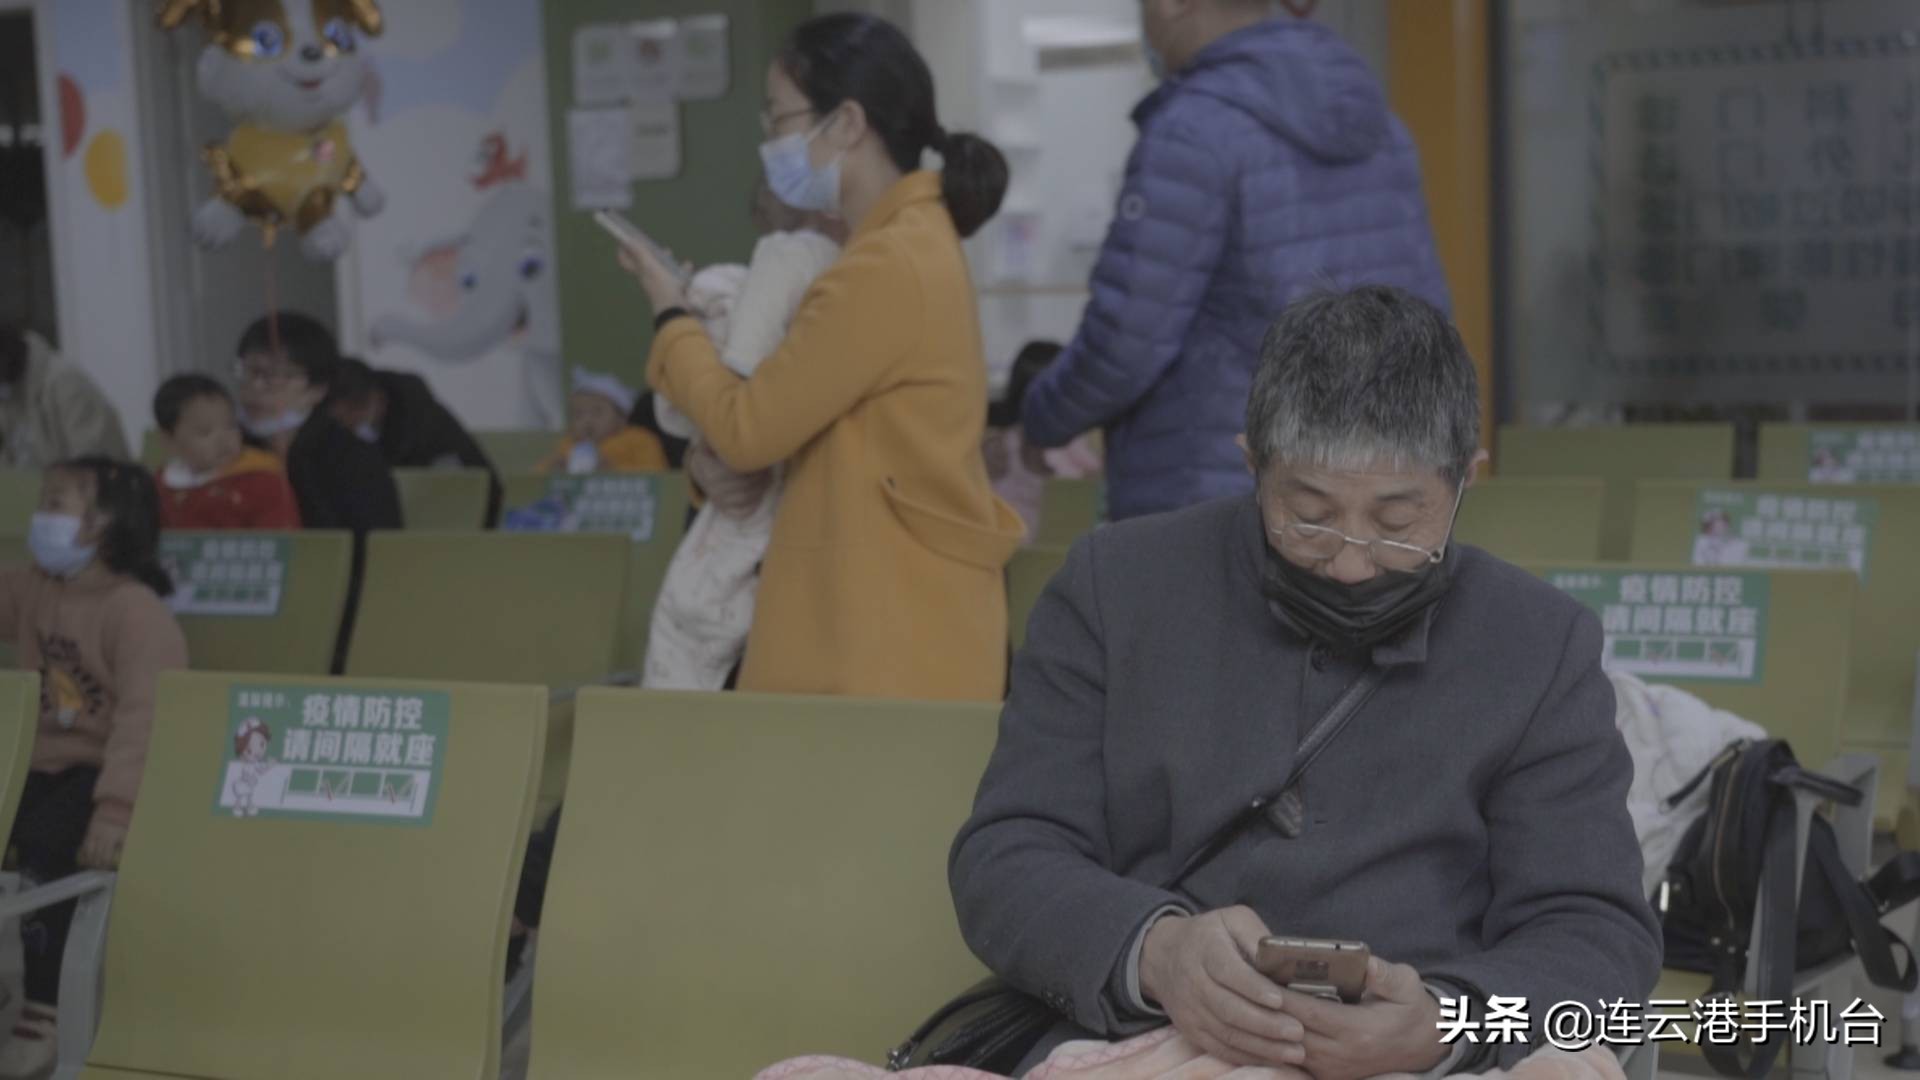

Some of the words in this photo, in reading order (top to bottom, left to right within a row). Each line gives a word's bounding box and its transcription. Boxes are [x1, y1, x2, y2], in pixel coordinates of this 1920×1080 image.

[1620, 574, 1744, 605] 疫情防控
[1603, 604, 1759, 635] 请间隔就座
[302, 692, 424, 730] 疫情防控
[282, 728, 436, 766] 请间隔就座
